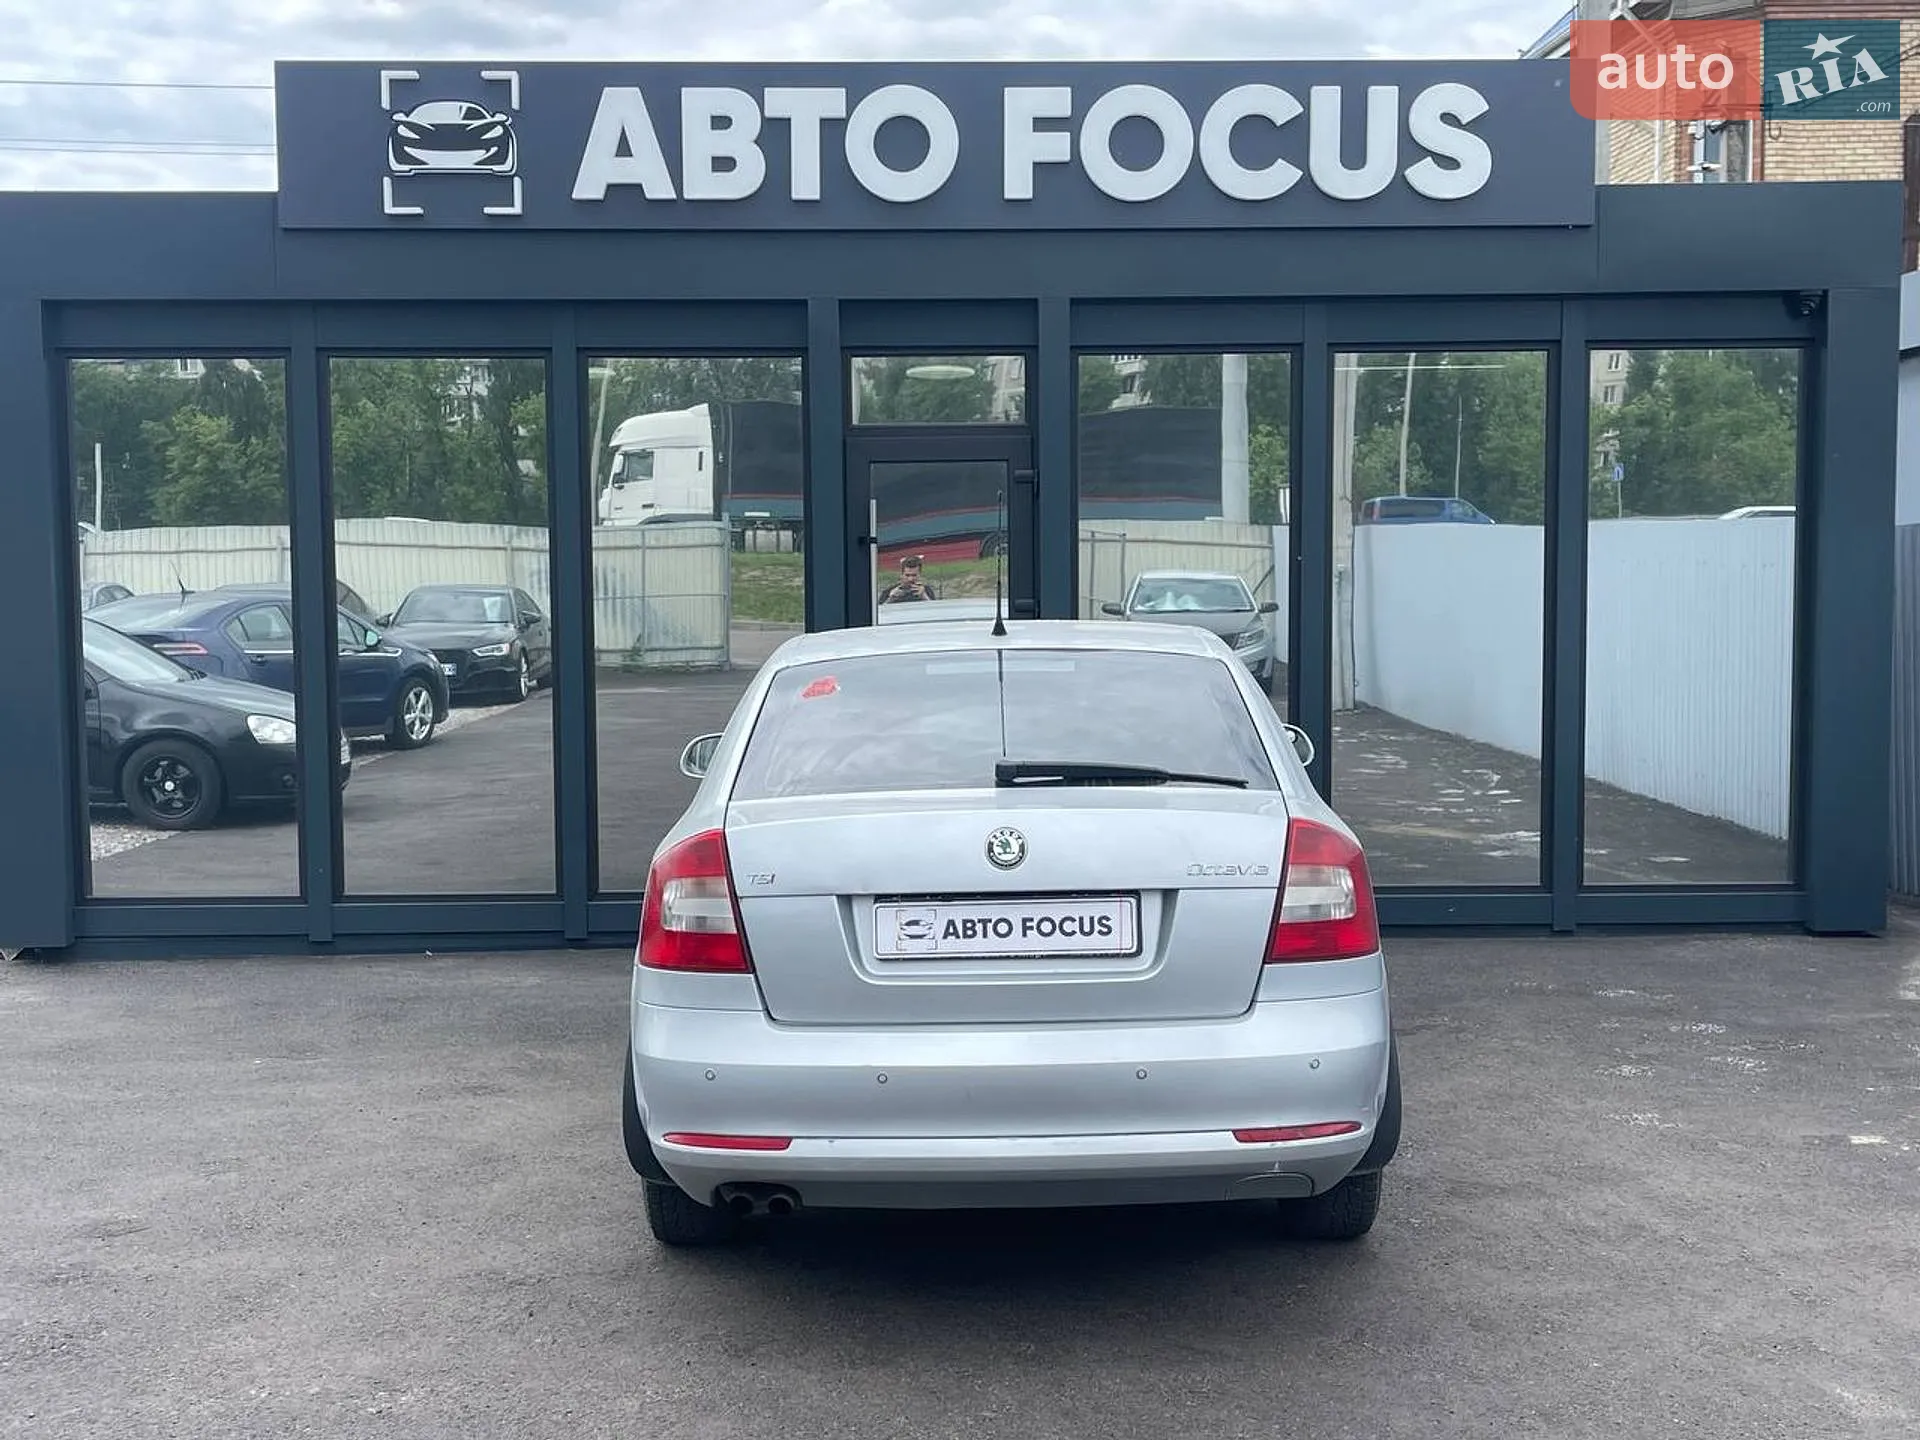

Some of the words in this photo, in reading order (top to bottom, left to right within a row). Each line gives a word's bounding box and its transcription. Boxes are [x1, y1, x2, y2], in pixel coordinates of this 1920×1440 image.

[571, 84, 960, 203] АВТО
[1003, 82, 1493, 202] FOCUS
[941, 917, 1014, 940] АВТО
[1021, 914, 1113, 938] FOCUS
